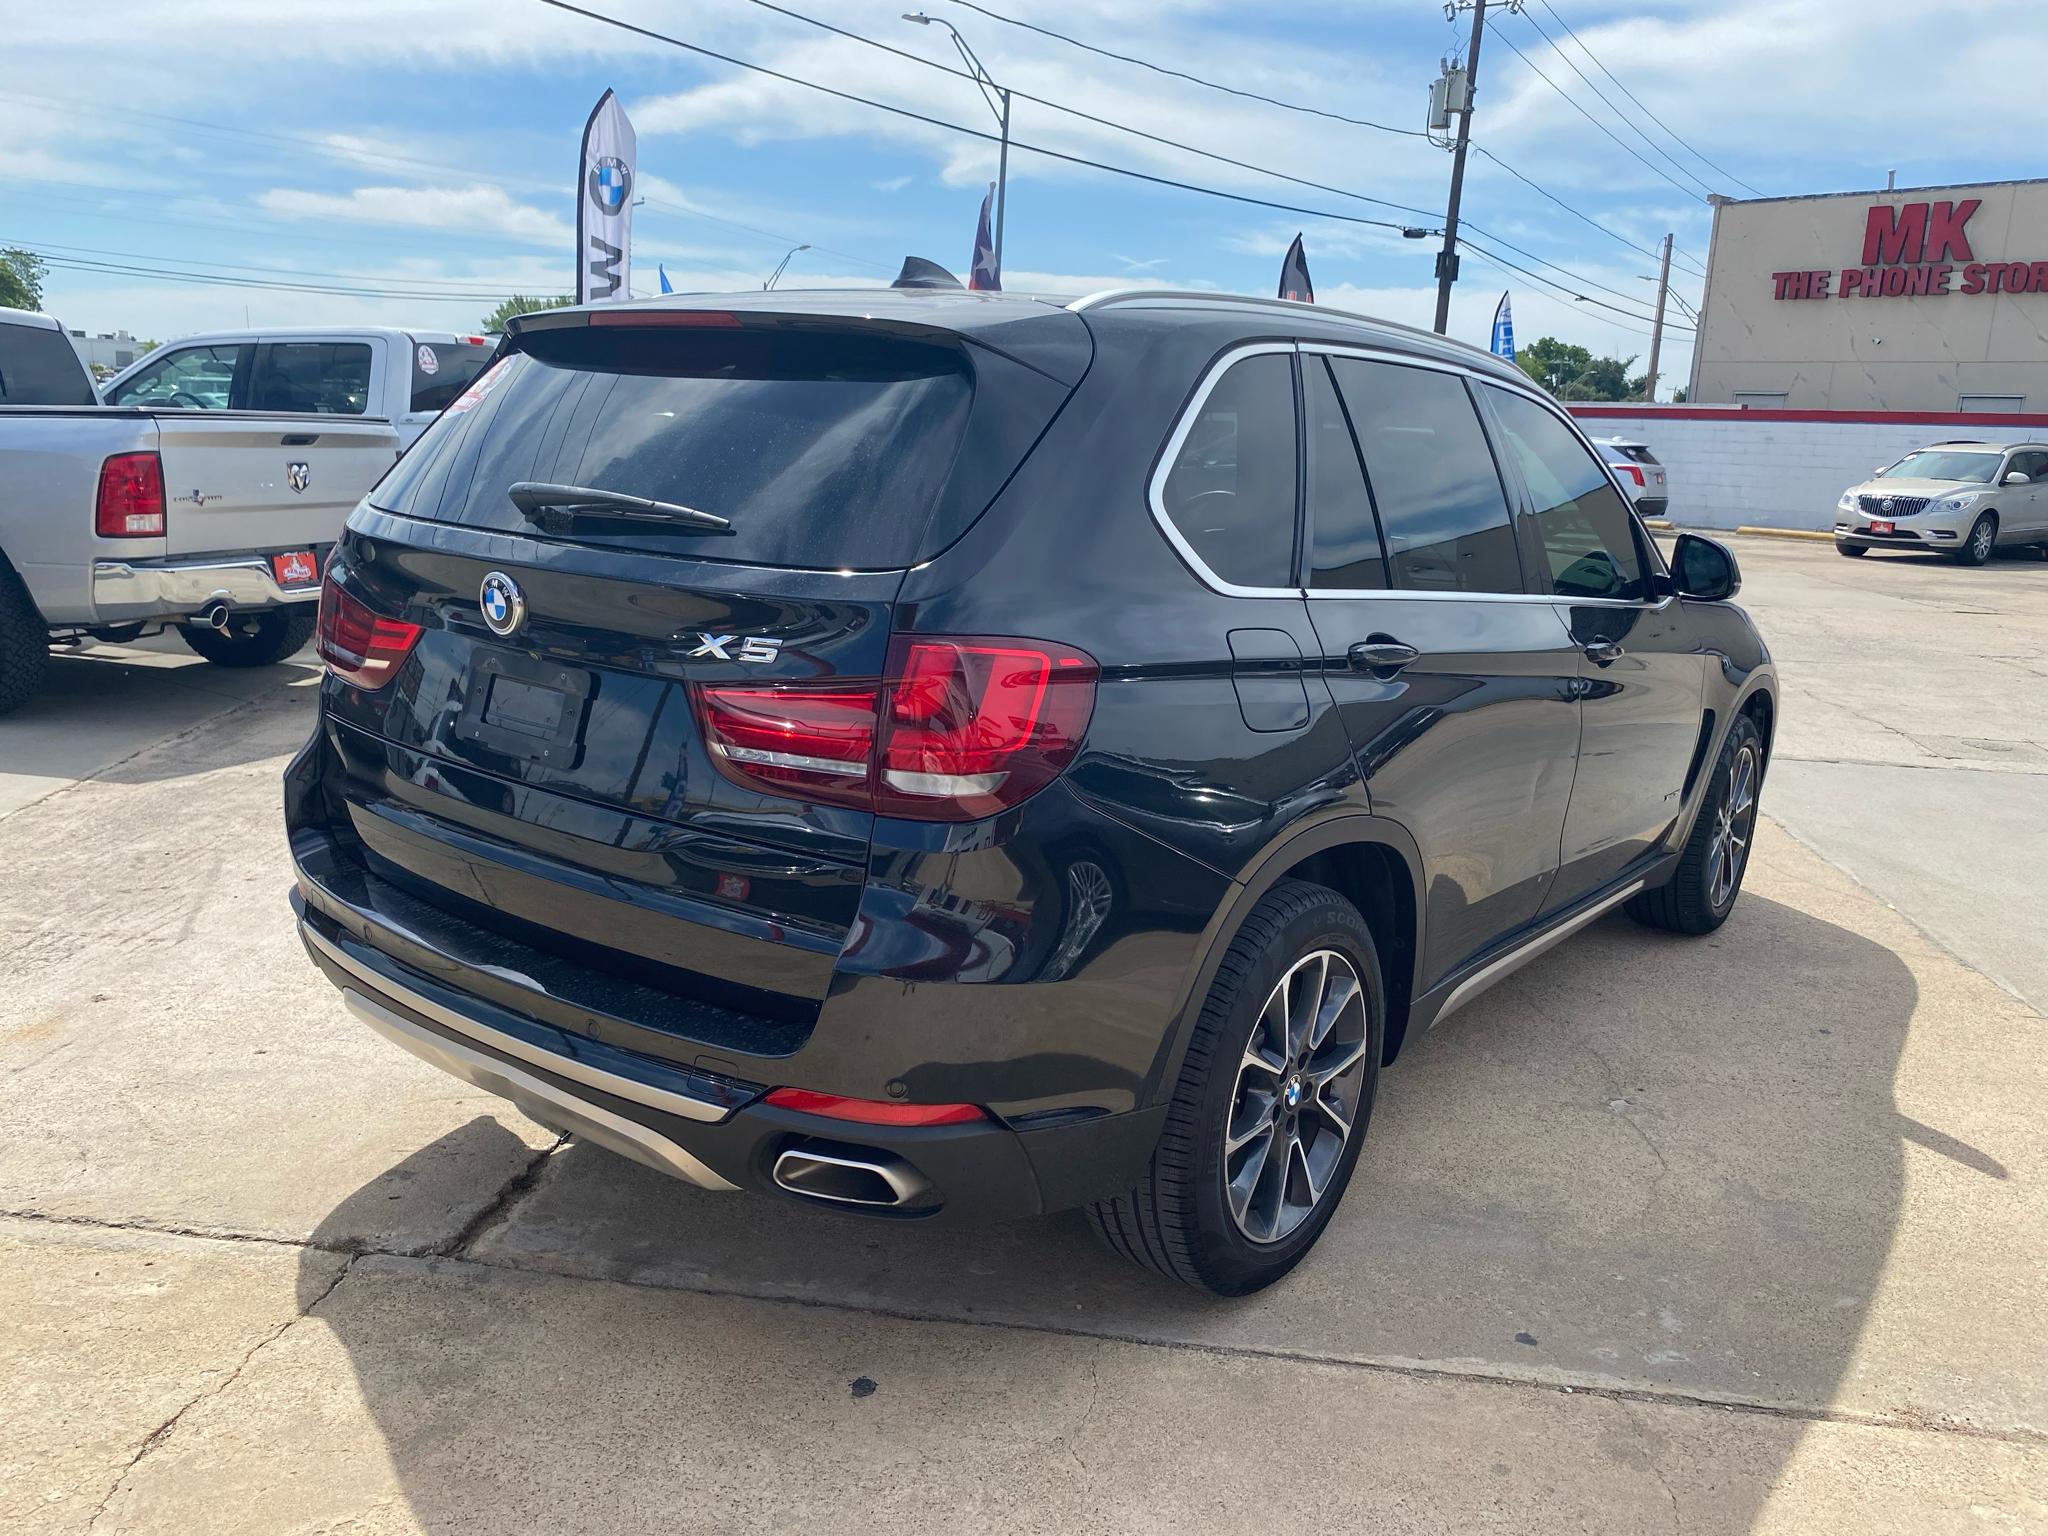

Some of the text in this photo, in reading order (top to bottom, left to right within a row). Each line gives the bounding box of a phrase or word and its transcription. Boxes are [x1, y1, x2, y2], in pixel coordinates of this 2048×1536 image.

[1862, 200, 1982, 265] MK
[1772, 271, 1831, 300] THE
[1839, 265, 1953, 298] PHONE
[686, 632, 783, 663] X5
